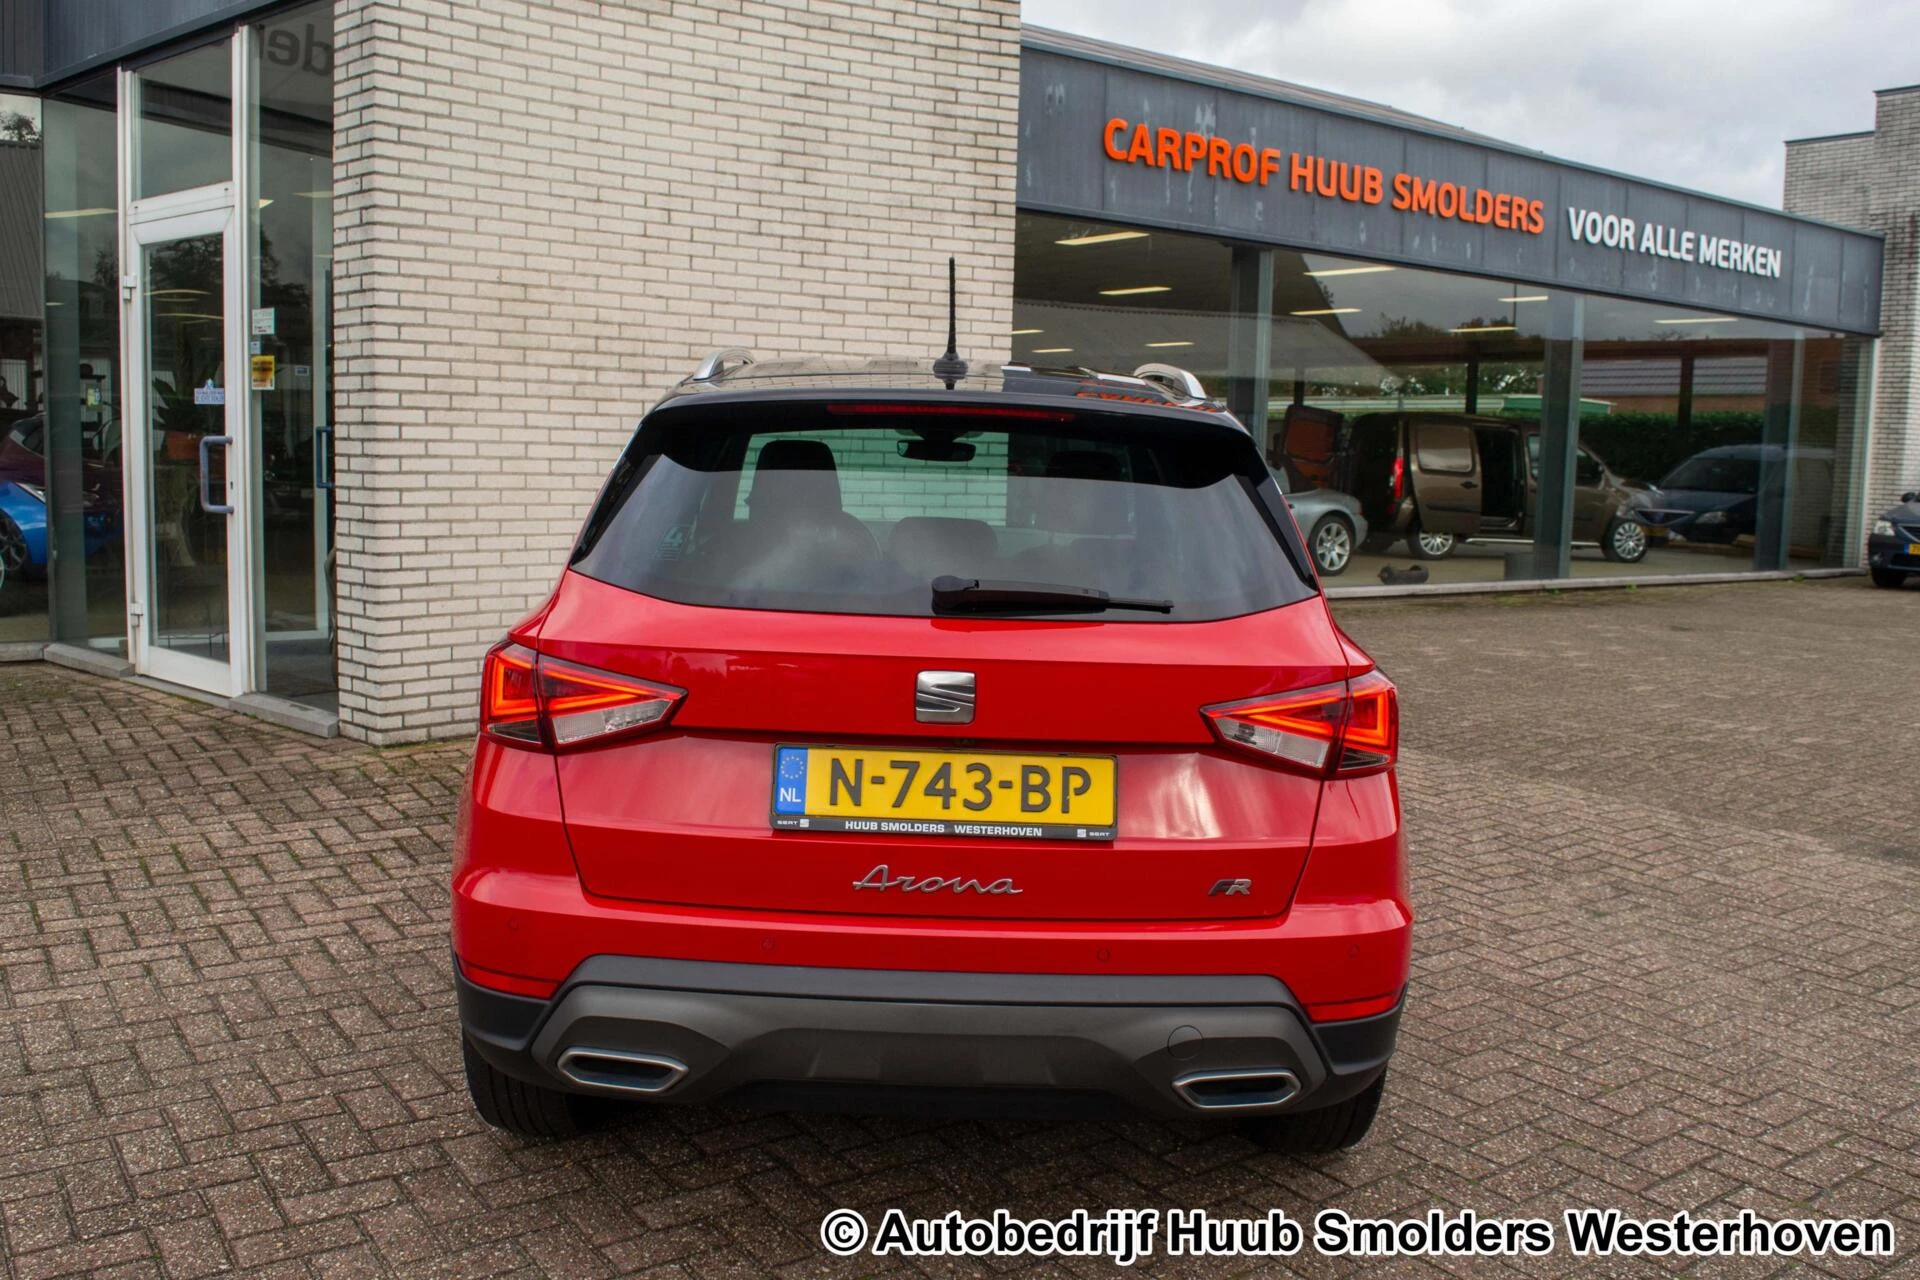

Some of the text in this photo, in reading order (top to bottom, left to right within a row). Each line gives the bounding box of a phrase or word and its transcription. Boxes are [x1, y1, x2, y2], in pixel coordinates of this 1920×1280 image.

[1103, 117, 1545, 235] CARPROF HUUB SMOLDERS
[1568, 206, 1782, 279] VOOR ALLE MERKEN
[779, 787, 802, 803] NL
[828, 756, 1092, 815] N-743-BP
[845, 820, 1042, 836] HUUB SMOLDERS WESTERHOVEN
[853, 864, 1024, 895] Arona
[1207, 878, 1252, 896] FR
